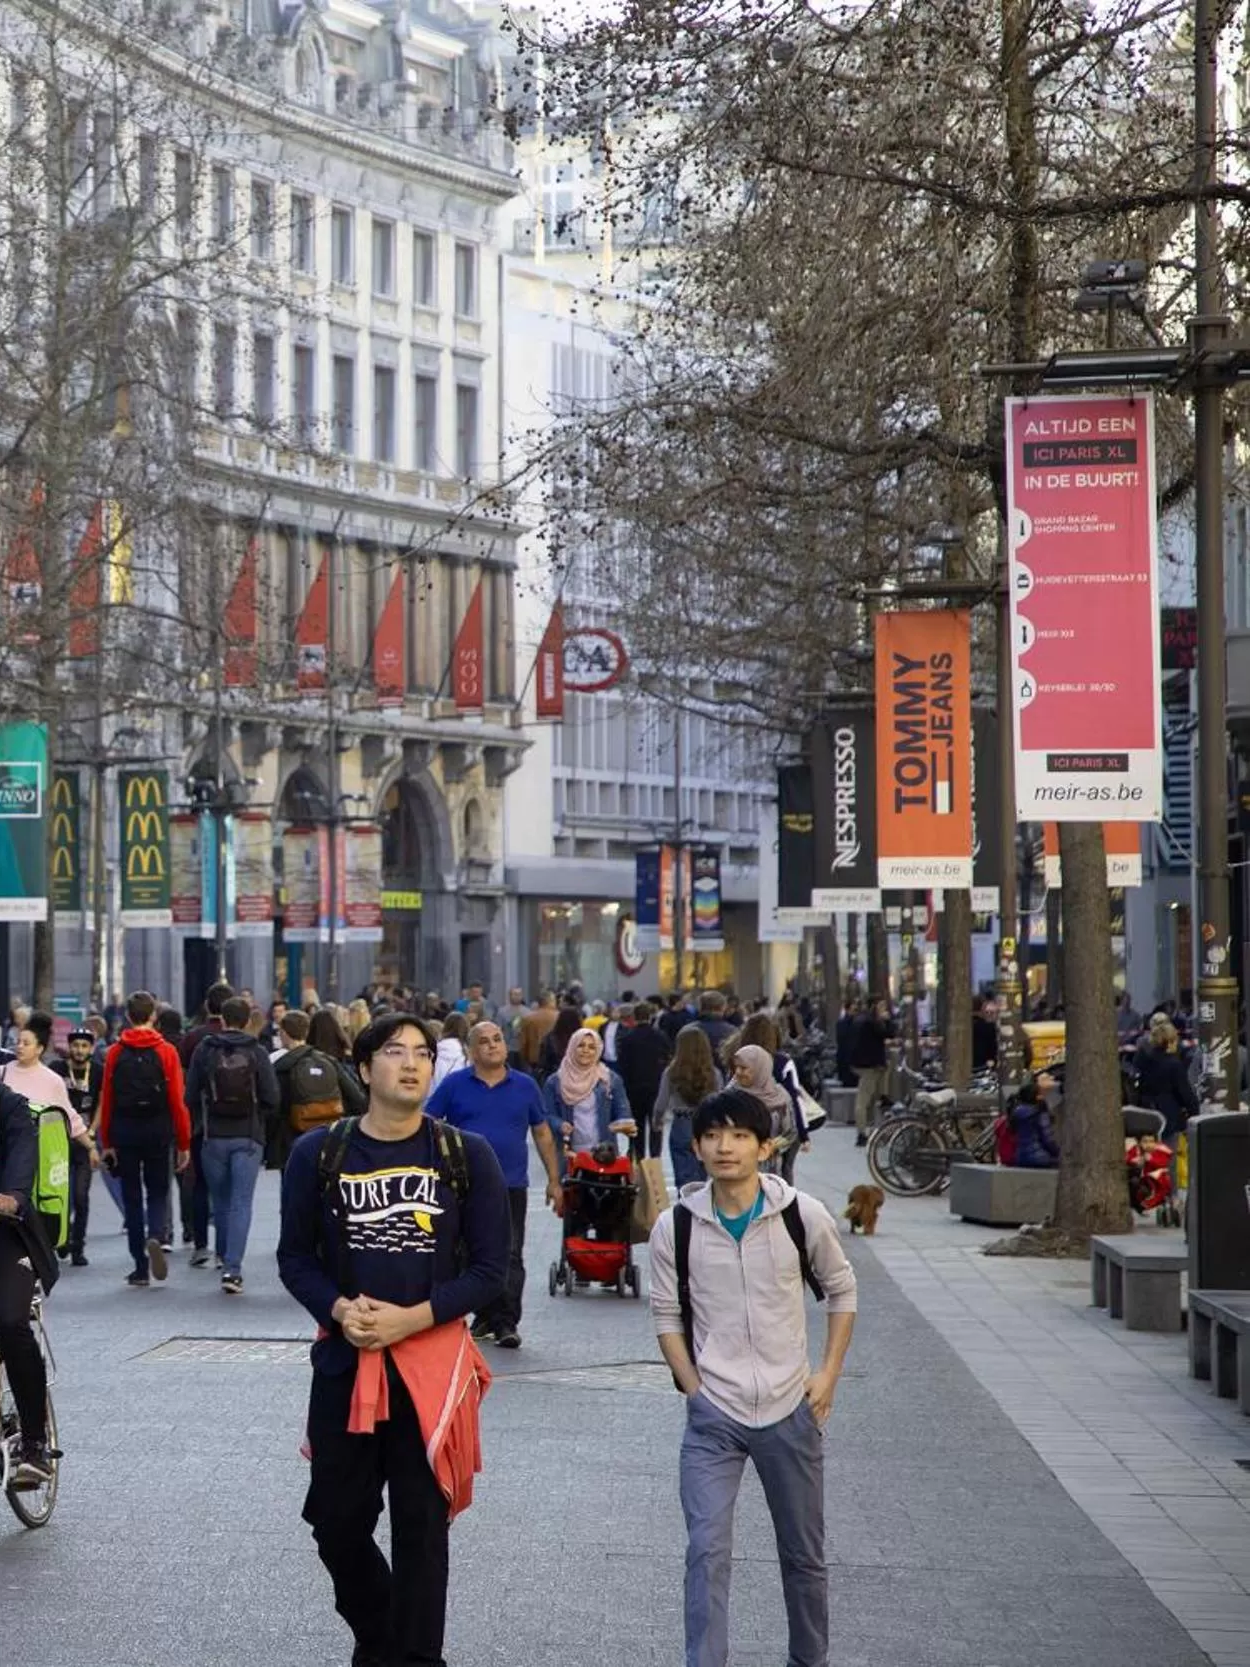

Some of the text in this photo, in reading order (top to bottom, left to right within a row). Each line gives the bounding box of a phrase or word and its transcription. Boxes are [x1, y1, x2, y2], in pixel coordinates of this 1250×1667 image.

[1024, 417, 1136, 436] ALTIJD EEN
[1034, 445, 1126, 461] ICI PARIS XL
[1024, 472, 1139, 489] IN DE BUURT!
[930, 652, 954, 748] JEANS
[893, 653, 929, 814] TOMMY
[1053, 757, 1121, 769] ICI PARIS XL
[831, 727, 862, 873] NESPRESSO
[1034, 783, 1143, 801] meir-as.be
[890, 863, 961, 877] meir-as.be
